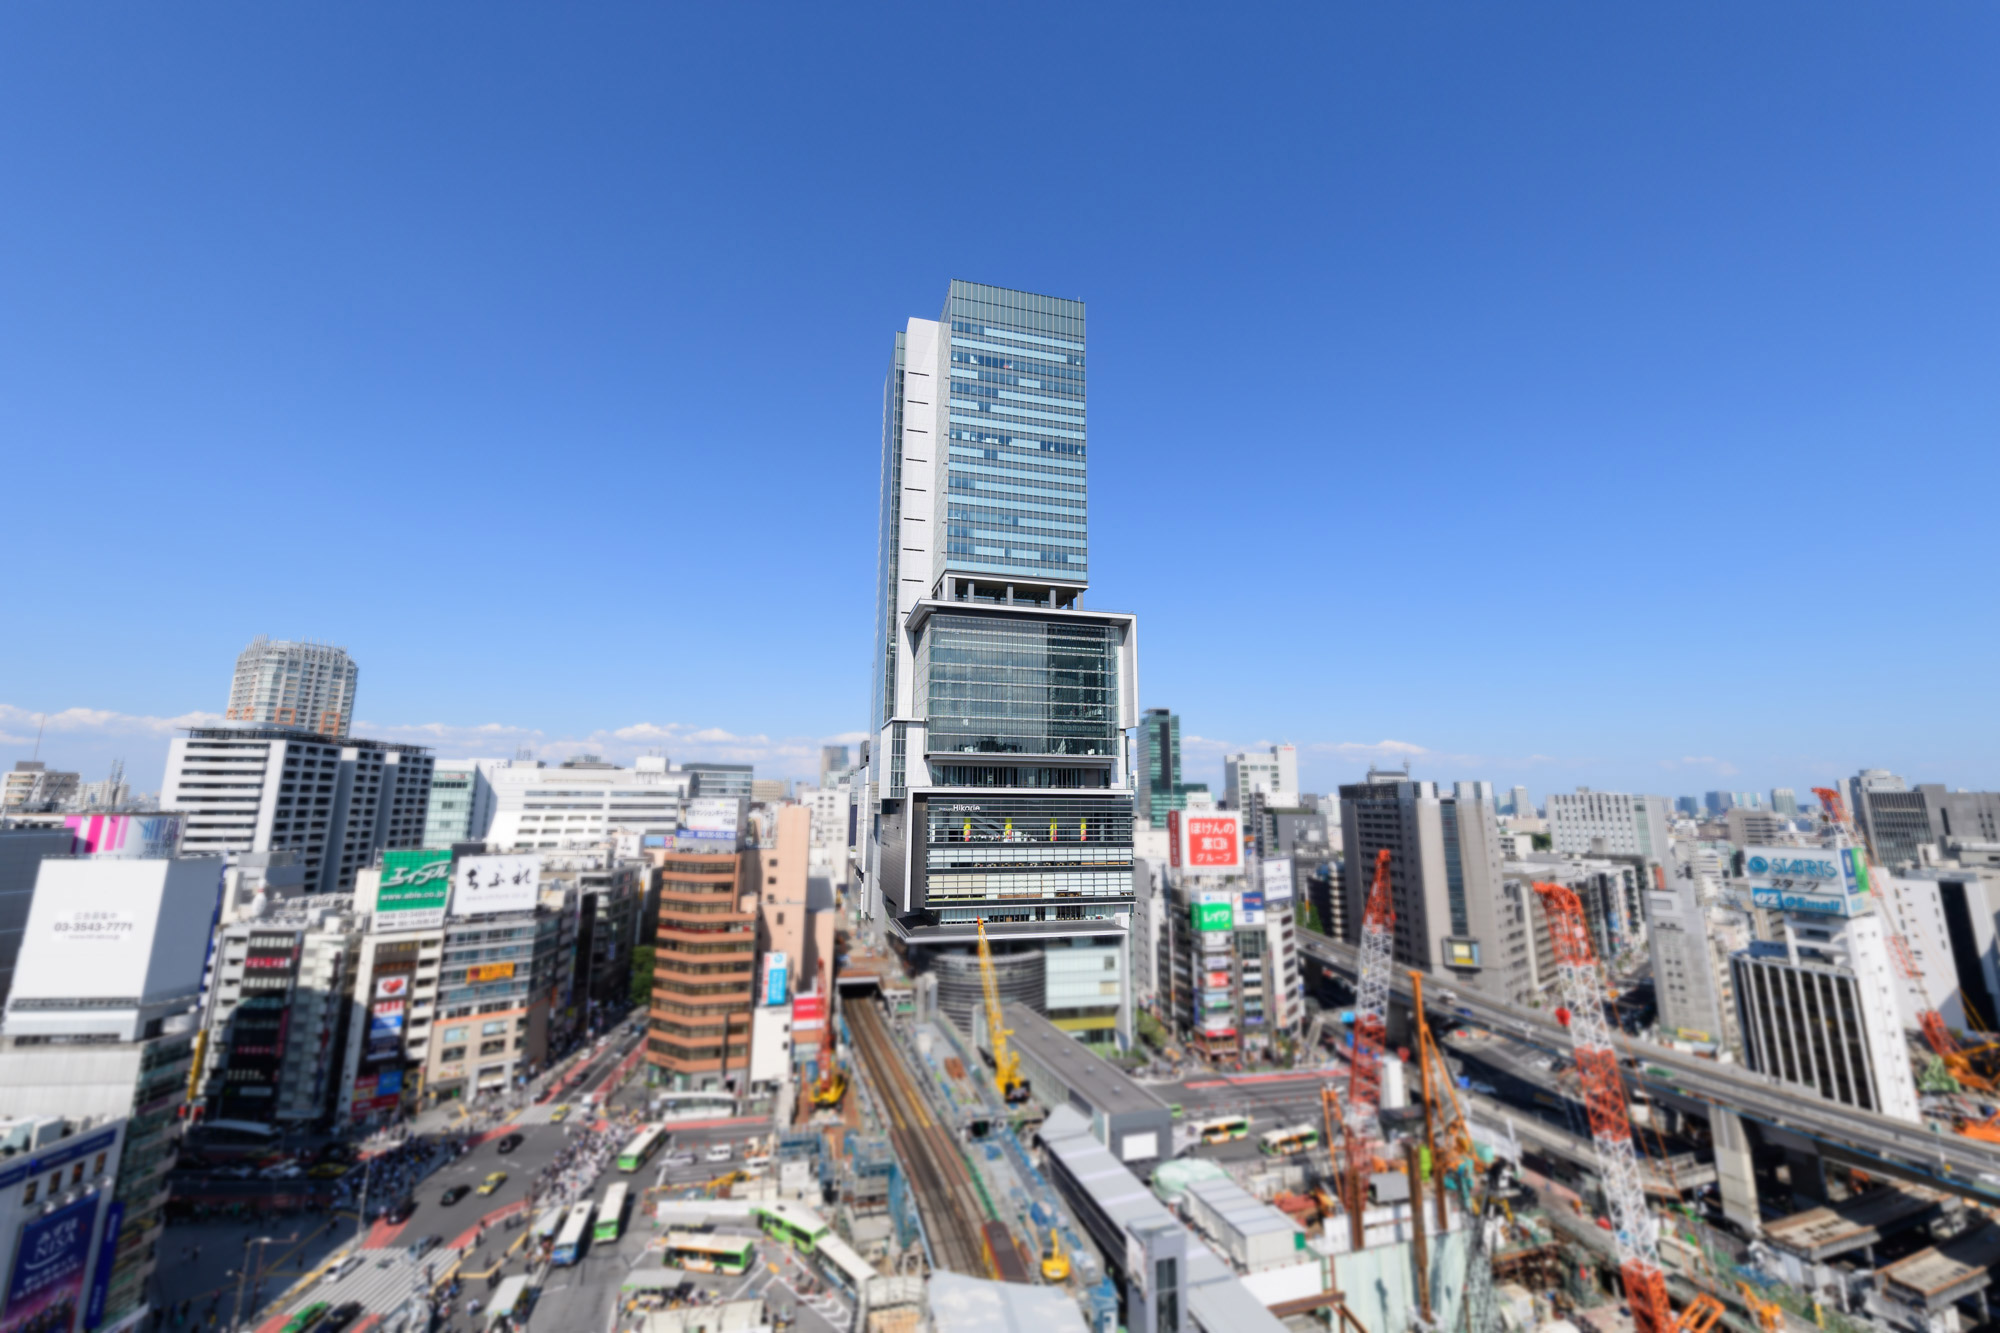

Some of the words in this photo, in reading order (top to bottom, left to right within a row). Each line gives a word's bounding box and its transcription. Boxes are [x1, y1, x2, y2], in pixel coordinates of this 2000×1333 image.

[1190, 822, 1235, 834] ほけんの
[1201, 837, 1228, 850] 窓口
[1196, 853, 1231, 862] グループ
[380, 860, 452, 887] エイブル
[1772, 858, 1838, 878] STARTS
[466, 868, 532, 890] ちふれ
[1771, 878, 1820, 891] スターツ
[381, 891, 446, 900] www.able.co.jp
[1203, 910, 1230, 922] レイク
[54, 922, 133, 932] 03-3543-7771
